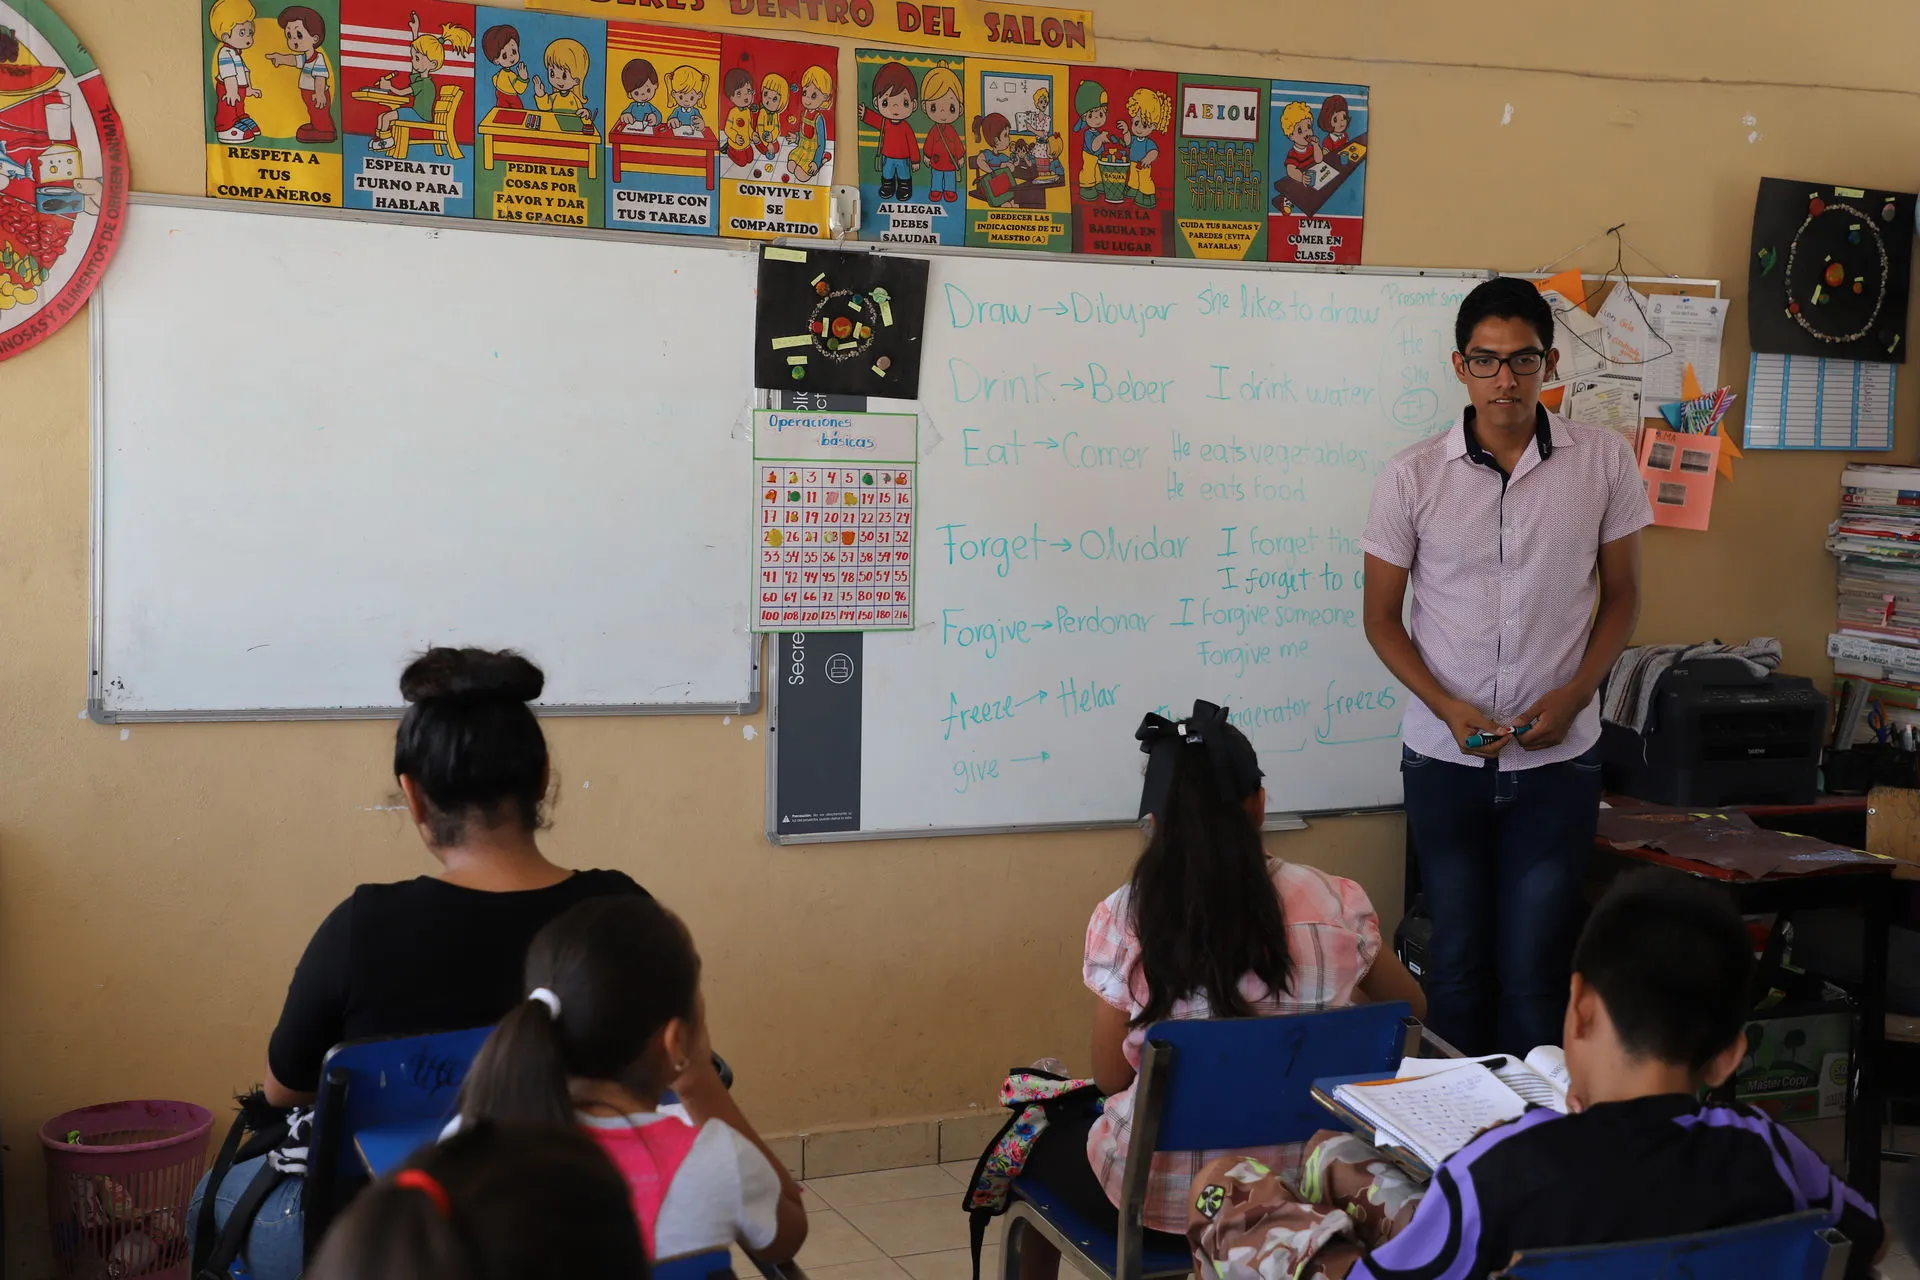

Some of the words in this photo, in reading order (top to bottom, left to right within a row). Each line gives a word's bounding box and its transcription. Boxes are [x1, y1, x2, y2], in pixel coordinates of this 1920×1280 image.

[896, 1, 961, 38] DEL
[984, 12, 1086, 48] SALON
[99, 103, 121, 162] ANIMAL
[228, 147, 304, 164] RESPETA
[307, 153, 320, 165] A
[257, 168, 291, 181] TUS
[365, 158, 425, 175] ESPERA
[429, 164, 451, 176] TU
[508, 162, 548, 176] PEDIR
[550, 166, 575, 178] LAS
[107, 166, 123, 219] ORIGEN
[356, 176, 412, 191] TURNO
[416, 182, 459, 196] PARA
[505, 178, 549, 191] COSAS
[551, 182, 577, 194] POR
[739, 184, 801, 199] CONVIVE
[803, 190, 812, 200] Y
[217, 185, 332, 204] COMPAÑEROS
[496, 193, 543, 206] FAVOR
[545, 197, 554, 207] Y
[557, 197, 585, 209] DAR
[616, 191, 675, 207] CUMPLE
[677, 195, 708, 208] CON
[375, 197, 441, 212] HABLAR
[766, 204, 783, 215] SE
[879, 204, 895, 214] AL
[897, 204, 942, 216] LLEGAR
[497, 209, 523, 221] LAS
[526, 211, 584, 225] GRACIAS
[617, 208, 646, 220] TUS
[648, 211, 707, 225] TAREAS
[990, 213, 1033, 222] OBEDECER
[1034, 214, 1050, 222] LAS
[1093, 208, 1131, 221] PONER
[1134, 211, 1150, 221] LA
[101, 222, 118, 242] DE
[730, 218, 819, 236] COMPARTIDO
[892, 219, 929, 230] DEBES
[977, 223, 1036, 232] INDICACIONES
[1038, 224, 1049, 232] DE
[1050, 225, 1061, 233] TU
[1089, 223, 1138, 236] BASURA
[1140, 225, 1156, 236] EN
[1180, 221, 1205, 229] CUIDA
[1222, 223, 1253, 231] BANCAS
[1299, 219, 1331, 229] EVITA
[882, 233, 938, 244] SALUDAR
[991, 233, 1031, 242] MAESTRO
[1032, 235, 1046, 244] (A)
[1189, 232, 1223, 240] PAREDES
[1224, 233, 1251, 241] (EVITA
[1288, 234, 1324, 245] COMER
[1326, 236, 1342, 245] EN
[1093, 240, 1110, 250] SU
[1112, 241, 1153, 252] LUGAR
[1197, 242, 1241, 251] RAYARLAS)
[1295, 251, 1334, 260] CLASES
[56, 242, 109, 315] ALIMENTOS
[944, 282, 1032, 329] Draw
[1070, 291, 1178, 338] Dibujar
[1197, 281, 1231, 316] She
[1239, 283, 1286, 321] likes
[1289, 290, 1314, 323] to
[1319, 292, 1381, 325] draw
[948, 356, 1056, 404] Drink
[1088, 361, 1175, 404] Beber
[1205, 365, 1231, 401] I
[1239, 370, 1298, 402] drink
[1306, 379, 1375, 405] water
[769, 414, 852, 432] Operaciones
[820, 431, 875, 449] básicas
[962, 428, 1027, 468] Eat
[1062, 430, 1151, 470] Comer
[1171, 430, 1192, 462] He
[1200, 434, 1248, 463] eats
[1250, 439, 1368, 473] vegetables
[807, 472, 816, 482] 3
[828, 472, 837, 484] 4
[846, 473, 854, 483] 5
[1167, 467, 1185, 501] He
[1200, 473, 1246, 501] eats
[807, 492, 817, 503] 11
[878, 493, 891, 503] 15
[897, 493, 909, 504] 16
[764, 510, 777, 523] 17
[805, 512, 819, 524] 19
[824, 512, 839, 523] 20
[842, 512, 856, 523] 21
[861, 513, 874, 522] 22
[879, 512, 891, 523] 23
[785, 530, 800, 542] 26
[860, 531, 874, 542] 30
[877, 532, 890, 543] 31
[896, 531, 909, 543] 32
[936, 522, 1048, 578] Forget
[1079, 525, 1190, 562] Olvidar
[1217, 526, 1239, 557] I
[1250, 525, 1320, 570] forget
[764, 550, 780, 562] 33
[785, 551, 800, 563] 34
[803, 552, 819, 562] 35
[822, 552, 835, 562] 36
[841, 552, 855, 562] 37
[859, 553, 873, 562] 38
[877, 552, 892, 561] 39
[896, 552, 909, 560] 40
[762, 571, 777, 583] 41
[785, 571, 798, 583] 42
[803, 572, 819, 583] 44
[821, 572, 836, 582] 45
[841, 572, 855, 583] 48
[858, 571, 873, 582] 50
[876, 570, 890, 582] 54
[894, 570, 908, 582] 55
[1217, 567, 1239, 590] I
[1245, 567, 1313, 600] forget
[1320, 562, 1343, 591] to
[762, 592, 778, 602] 60
[783, 592, 798, 603] 64
[803, 592, 816, 601] 66
[822, 592, 833, 601] 72
[841, 592, 853, 600] 75
[858, 591, 873, 600] 80
[876, 592, 891, 600] 90
[893, 591, 907, 601] 96
[761, 610, 780, 620] 100
[783, 611, 799, 620] 108
[801, 612, 819, 621] 120
[820, 611, 836, 620] 125
[839, 611, 855, 620] 144
[857, 611, 874, 620] 150
[877, 610, 891, 619] 180
[1169, 598, 1196, 627] I
[1275, 604, 1358, 628] someone
[942, 608, 1032, 659] Forgive
[1056, 605, 1156, 635] Perdonar
[1280, 639, 1312, 660] me
[941, 691, 1016, 740] freeze
[1057, 676, 1121, 718] Helar
[1322, 680, 1397, 739] freezes
[952, 759, 1000, 794] give
